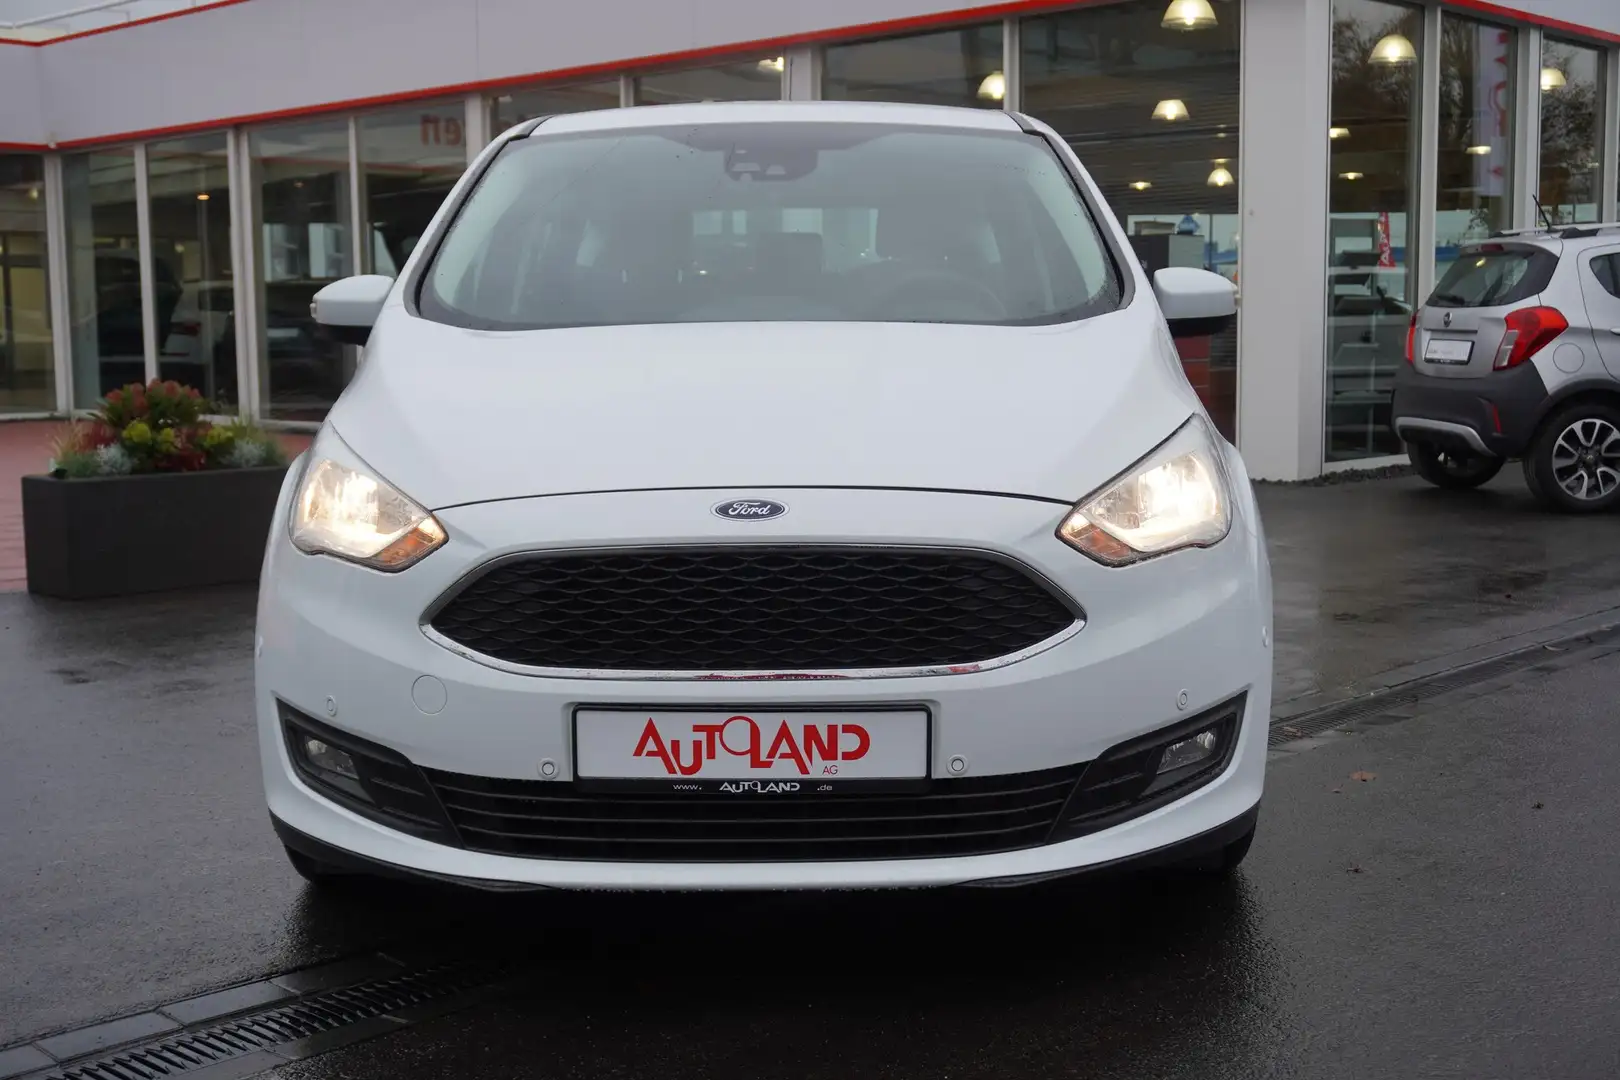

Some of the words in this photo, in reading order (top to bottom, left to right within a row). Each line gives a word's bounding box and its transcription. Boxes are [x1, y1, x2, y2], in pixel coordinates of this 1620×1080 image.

[728, 501, 771, 515] Ford
[632, 715, 871, 776] AUTOLAND
[821, 764, 839, 776] AG
[672, 783, 703, 791] www.
[719, 780, 801, 793] AUTOLAND
[816, 783, 833, 791] .de
